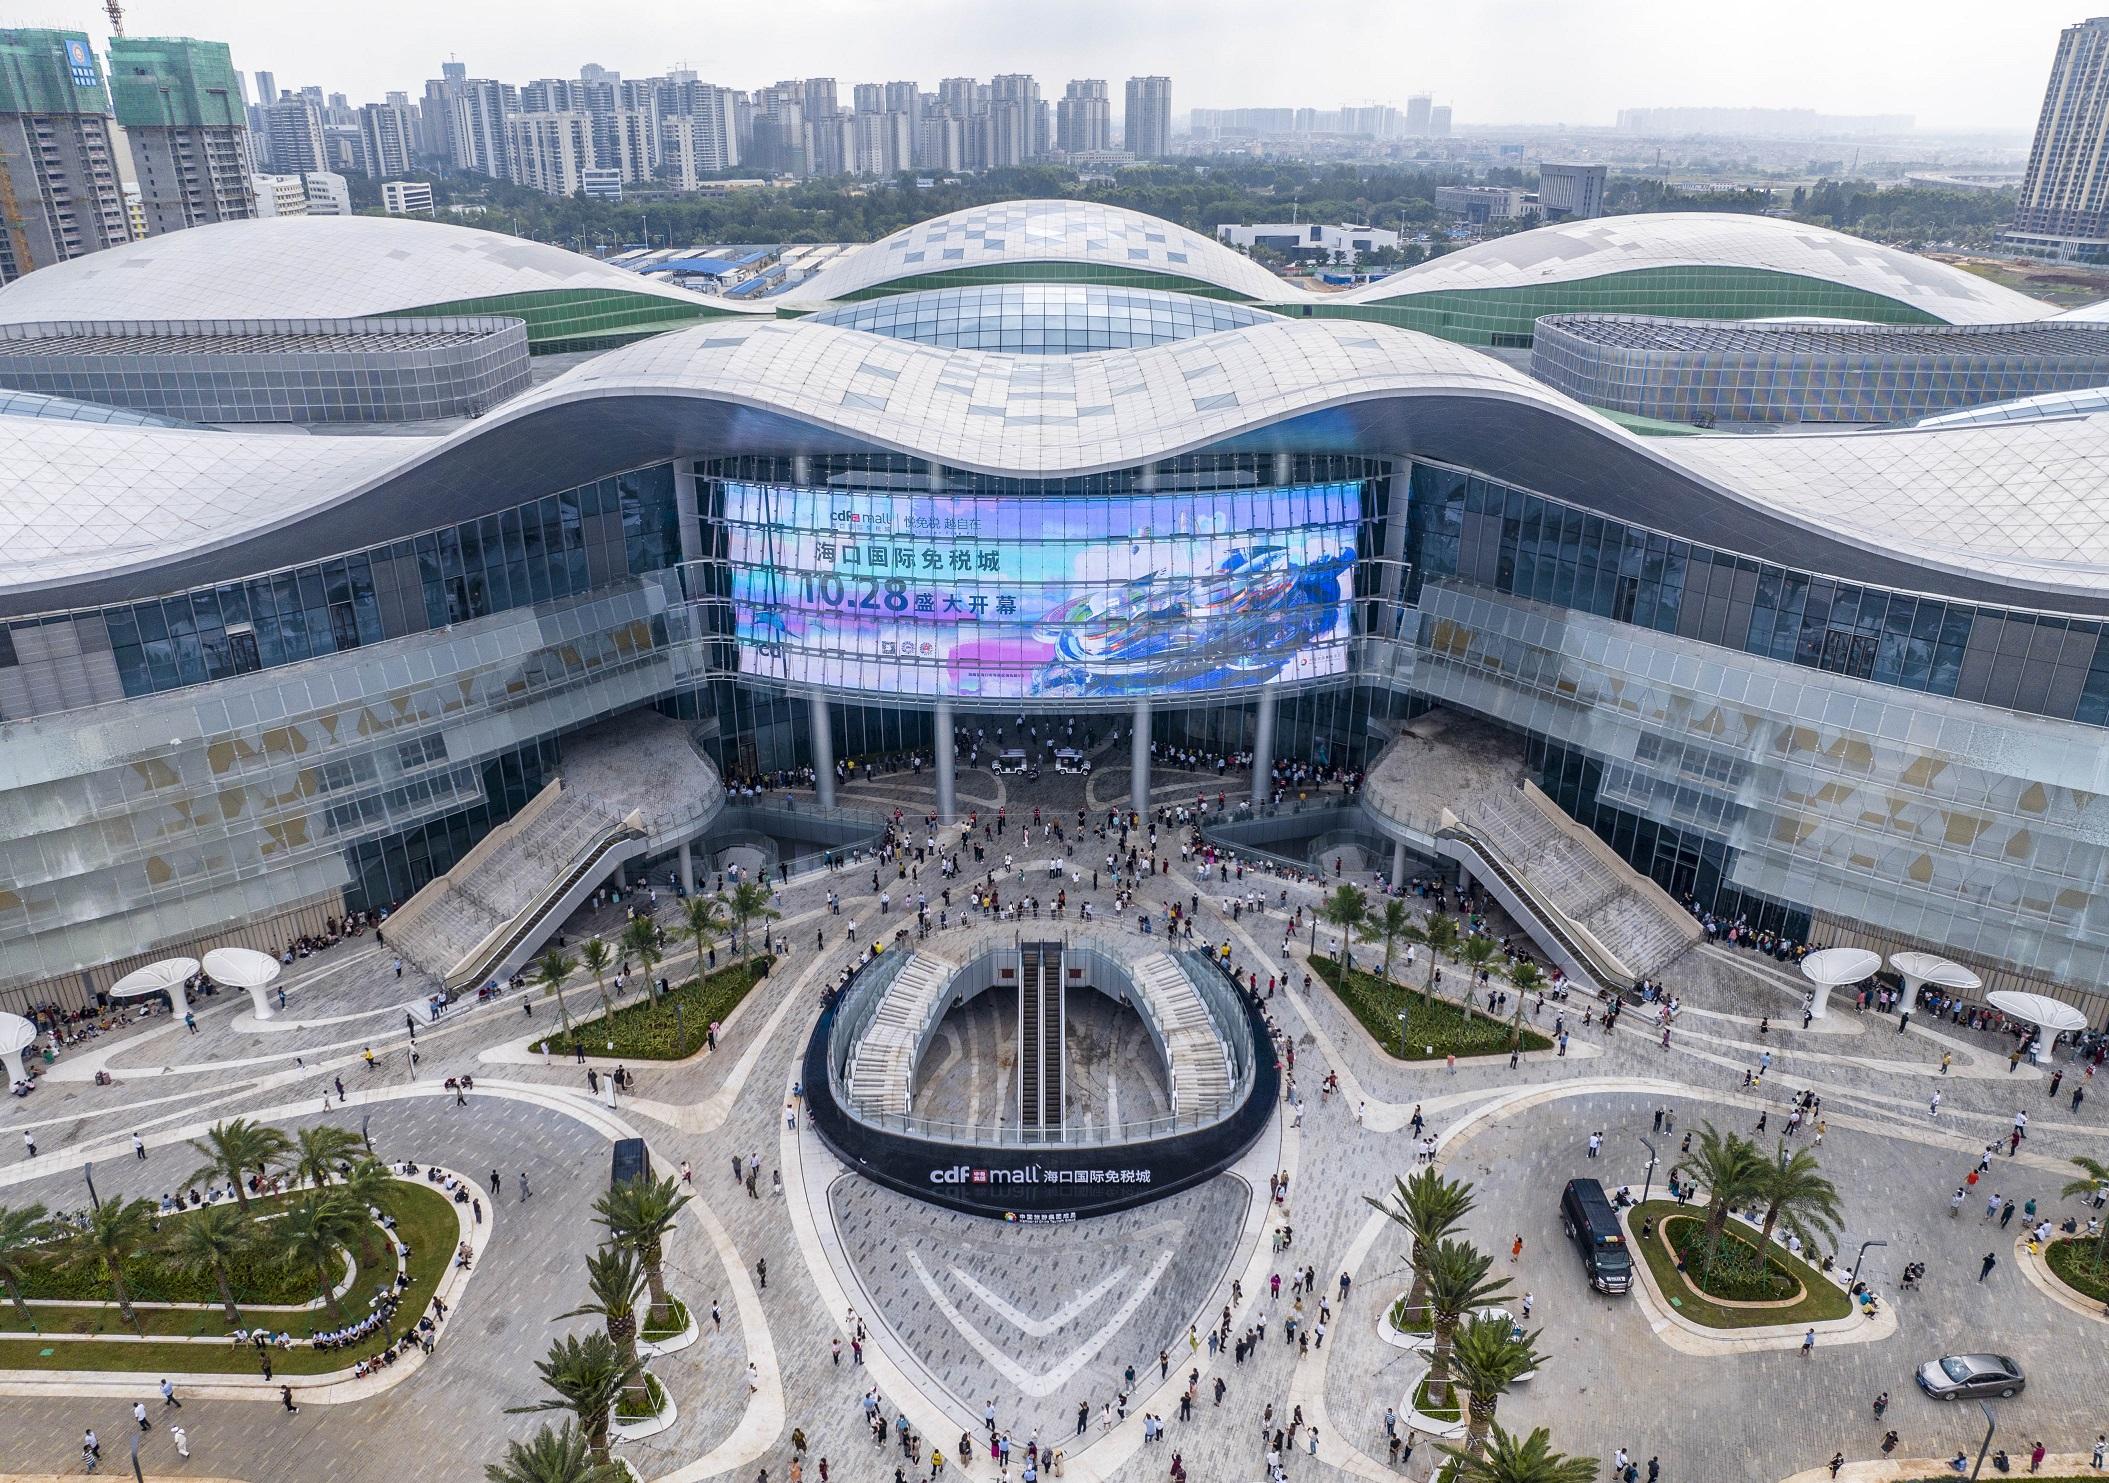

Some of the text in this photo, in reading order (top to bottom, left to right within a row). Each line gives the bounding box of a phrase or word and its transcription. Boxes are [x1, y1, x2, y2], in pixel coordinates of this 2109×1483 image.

[862, 513, 891, 524] mall
[944, 517, 981, 529] 越自在
[816, 542, 1000, 572] 海口国际免税城
[801, 573, 1016, 615] 10.28 盛大开幕
[930, 1166, 970, 1183] cdf
[990, 1166, 1039, 1183] mall
[1043, 1169, 1151, 1183] 海口国际免税城
